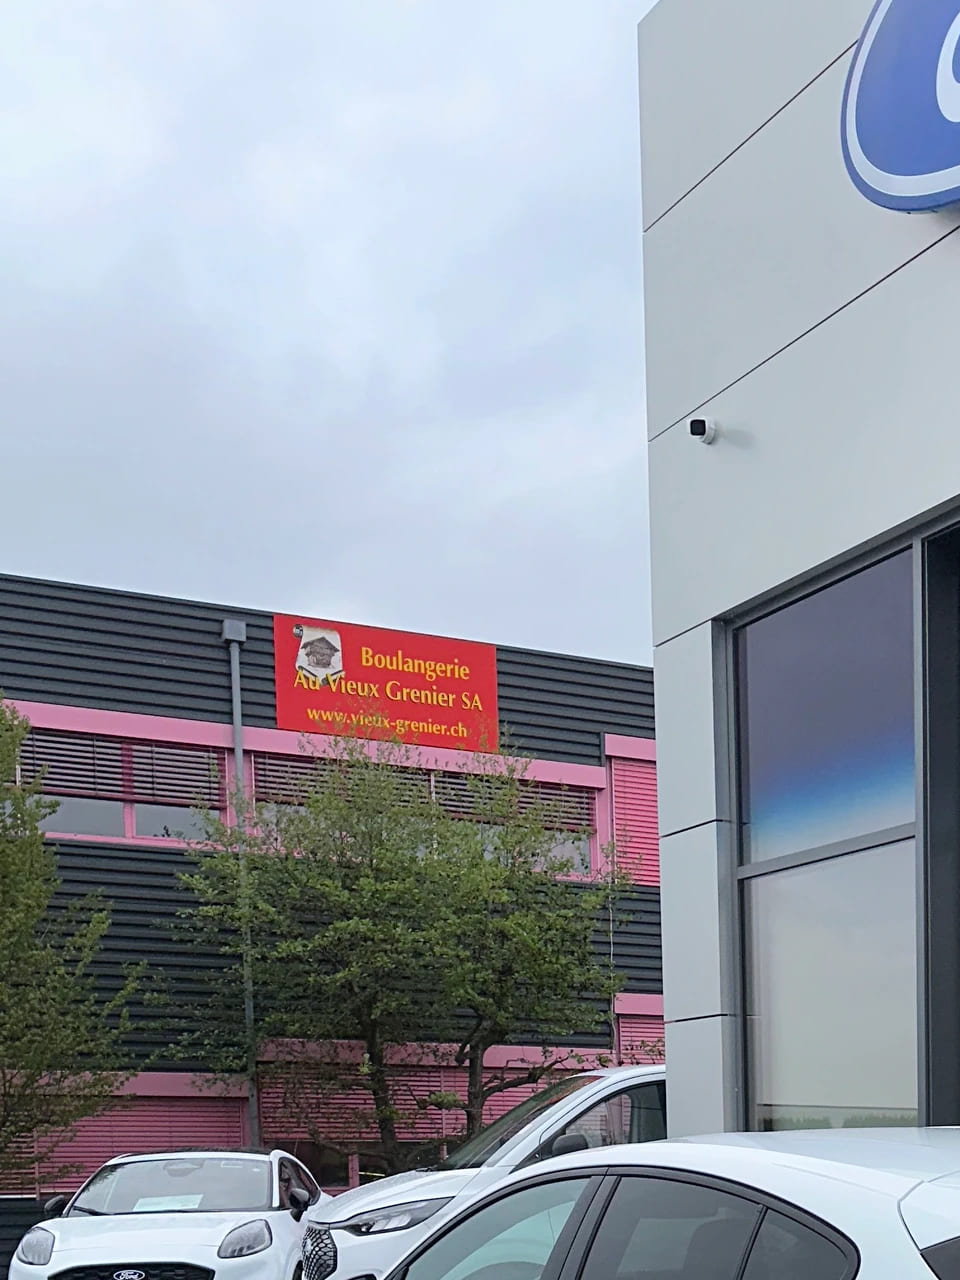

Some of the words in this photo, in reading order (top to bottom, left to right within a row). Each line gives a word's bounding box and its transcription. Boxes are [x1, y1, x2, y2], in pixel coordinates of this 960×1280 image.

[361, 647, 470, 681] Boulangerie
[293, 670, 320, 691] Au
[326, 672, 379, 698] Vieux
[385, 680, 456, 708] Grenier
[462, 692, 483, 711] SA
[307, 708, 468, 738] www.vieux-grenier.ch
